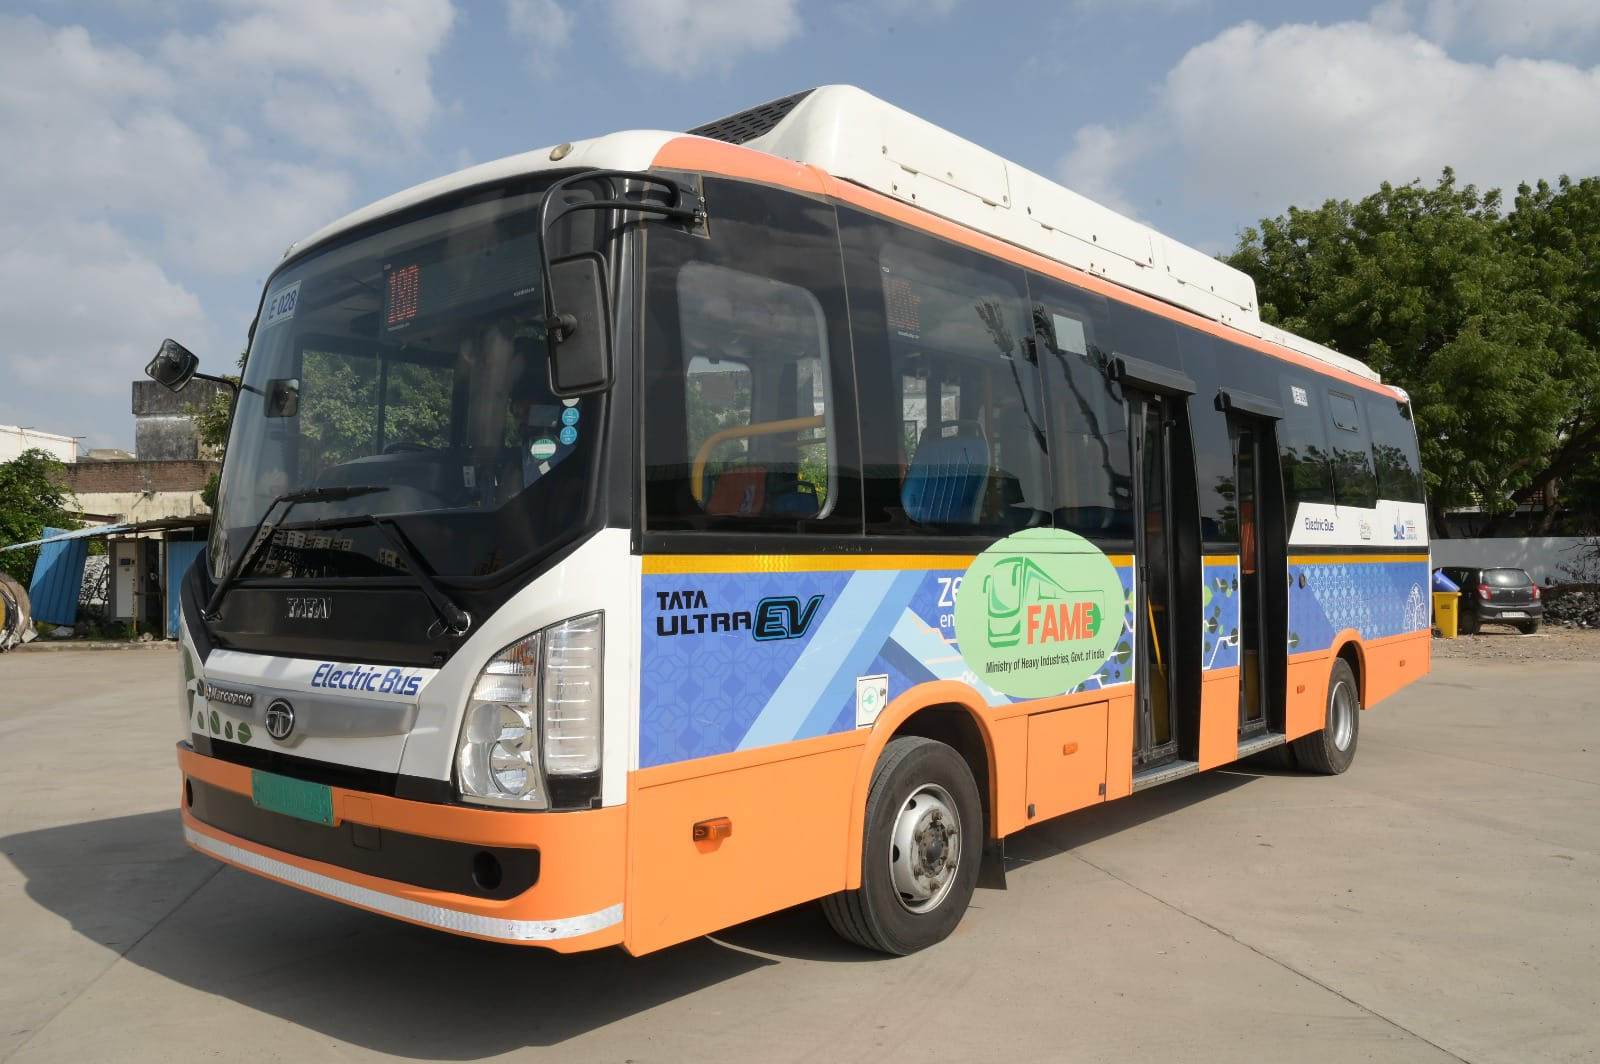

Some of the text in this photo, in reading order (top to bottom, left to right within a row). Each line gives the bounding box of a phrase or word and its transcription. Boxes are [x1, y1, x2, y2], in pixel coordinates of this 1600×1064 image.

[1304, 517, 1335, 532] Electric Bus
[656, 590, 708, 611] TATA
[656, 611, 752, 637] ULTRA
[1027, 601, 1094, 645] FAME
[986, 660, 1012, 674] Ministry
[1013, 658, 1020, 671] of
[1021, 657, 1040, 670] Heavy
[1091, 648, 1105, 660] India
[311, 664, 422, 696] Electric Bus
